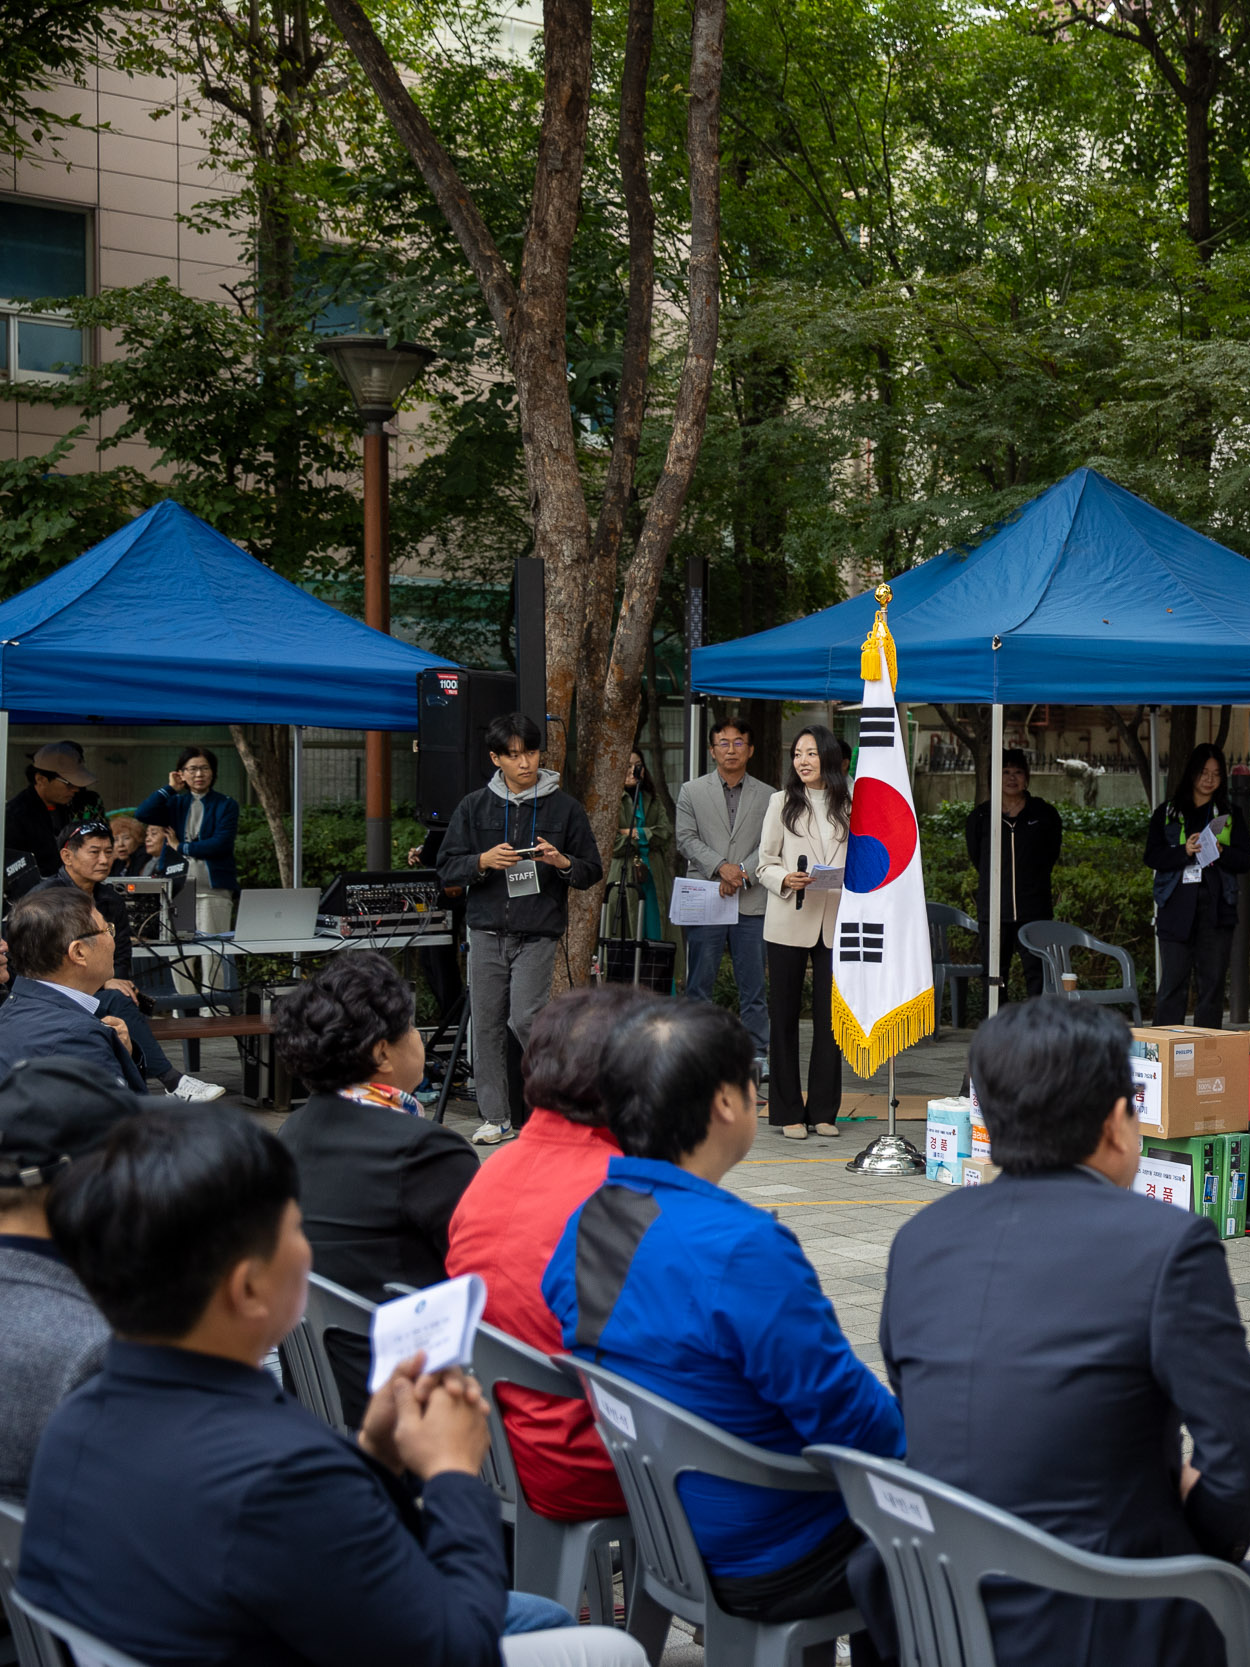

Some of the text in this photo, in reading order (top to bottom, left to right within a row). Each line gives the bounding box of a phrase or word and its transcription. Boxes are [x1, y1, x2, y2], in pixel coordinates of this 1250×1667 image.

[6, 856, 28, 877] SHURE
[165, 862, 186, 875] SHURE
[509, 871, 534, 881] STAFF
